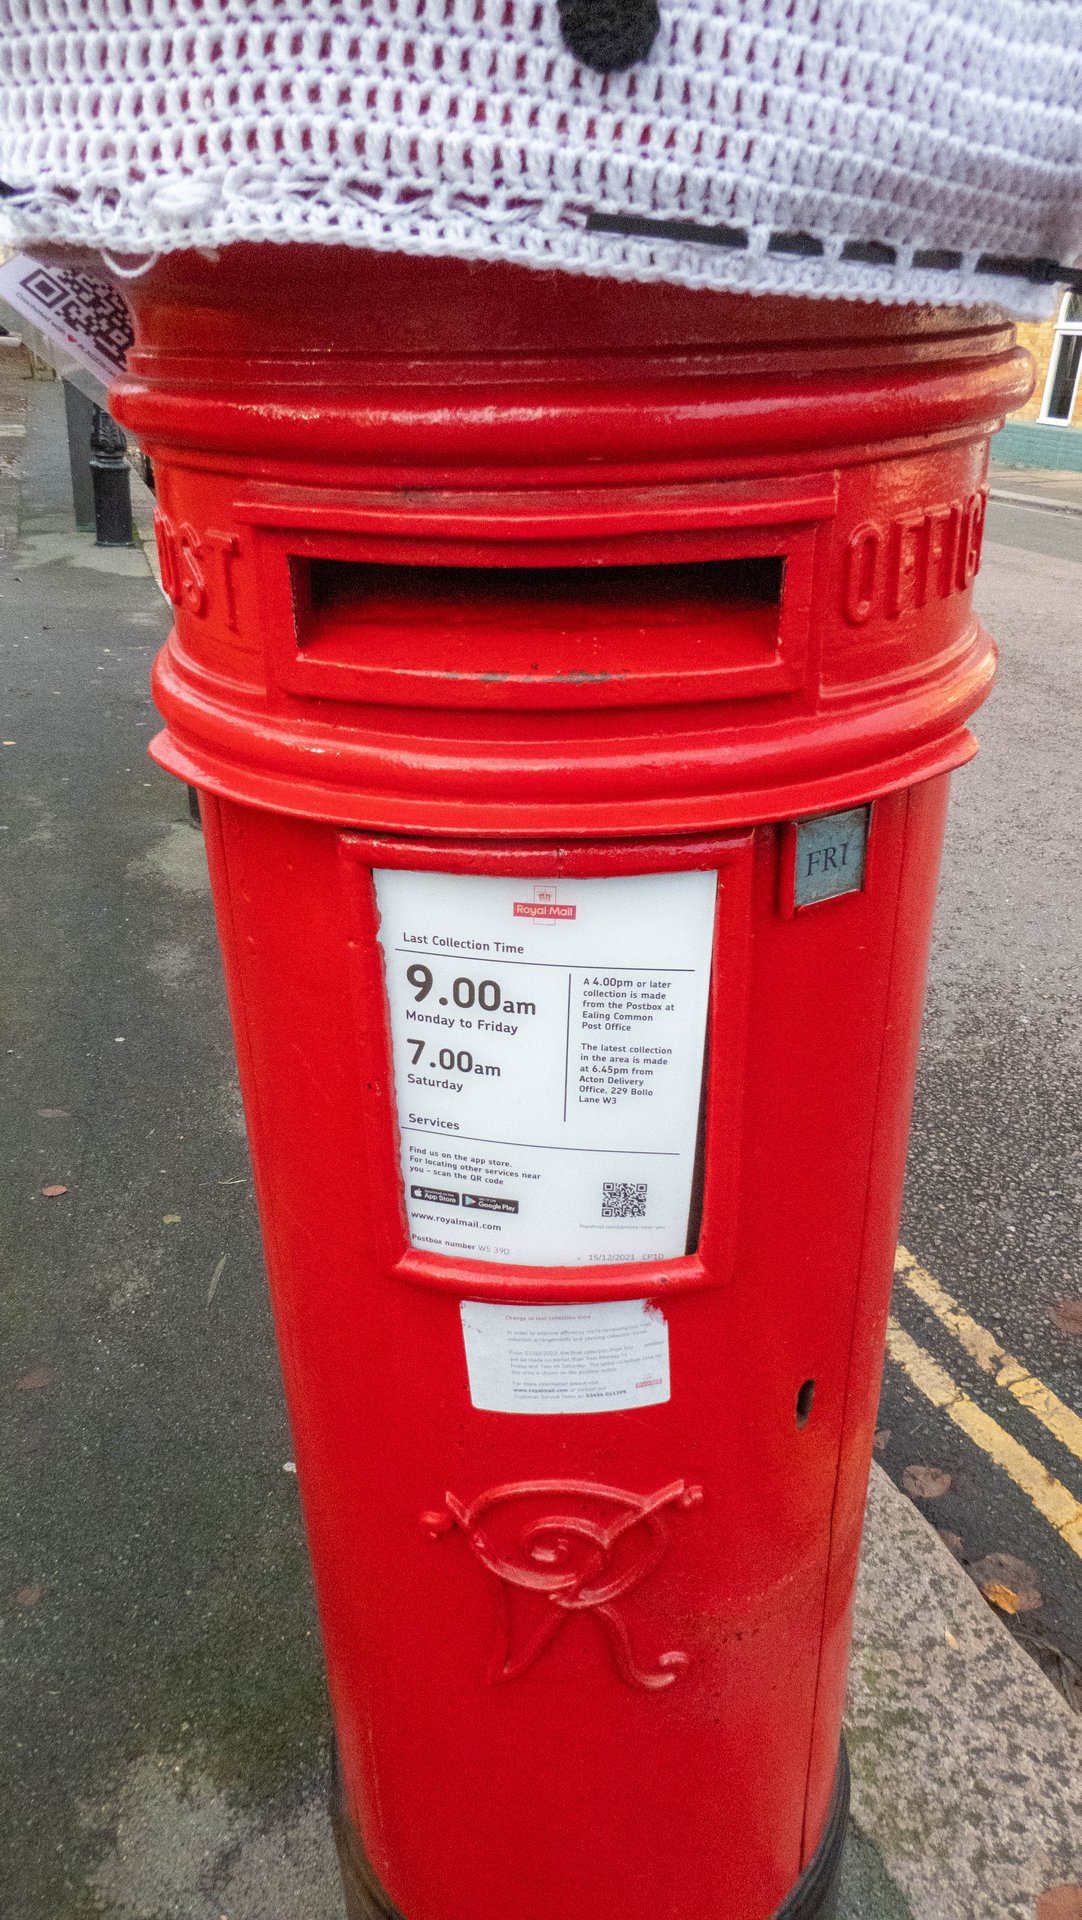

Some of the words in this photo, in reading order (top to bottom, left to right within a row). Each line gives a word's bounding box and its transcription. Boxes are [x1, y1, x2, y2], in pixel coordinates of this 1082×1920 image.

[153, 506, 240, 636] OST
[805, 842, 849, 878] FRI
[516, 904, 547, 916] Royal
[549, 906, 573, 917] Mail
[403, 932, 428, 945] Last
[432, 935, 490, 951] Collection
[494, 941, 524, 954] Time
[406, 963, 536, 1015] 9.00am
[583, 978, 590, 986] A
[592, 977, 633, 988] 4.00pm
[650, 980, 672, 988] later
[583, 989, 627, 998] collection
[630, 991, 638, 999] is
[641, 992, 666, 1000] made
[582, 1000, 605, 1008] from
[608, 1002, 623, 1010] the
[626, 1002, 662, 1011] Postbox
[406, 1009, 455, 1028] Monday
[460, 1018, 472, 1029] to
[478, 1019, 518, 1036] Friday
[582, 1011, 610, 1020] Ealing
[614, 1012, 654, 1022] Common
[582, 1022, 602, 1030] Post
[604, 1022, 632, 1032] Office
[580, 1042, 598, 1050] The
[600, 1044, 626, 1052] latest
[630, 1046, 672, 1054] collection
[406, 1038, 501, 1077] 7.00am
[592, 1054, 606, 1062] the
[610, 1056, 630, 1064] area
[632, 1056, 640, 1064] is
[592, 1065, 628, 1075] 6.45pm
[407, 1073, 464, 1093] Saturday
[608, 1076, 644, 1086] Delivery
[579, 1085, 608, 1094] Office,
[630, 1088, 654, 1096] Bollo
[578, 1096, 600, 1104] Lane
[602, 1096, 617, 1104] W3
[408, 1113, 460, 1130] Services
[409, 1146, 426, 1155] Find
[454, 1152, 468, 1162] the
[470, 1156, 486, 1166] app
[488, 1159, 512, 1168] store.
[410, 1155, 422, 1163] For
[426, 1158, 458, 1170] locating
[460, 1164, 482, 1172] other
[484, 1168, 519, 1178] services
[522, 1172, 542, 1180] near
[433, 1169, 452, 1177] scan
[454, 1172, 468, 1180] the
[470, 1174, 482, 1182] QR
[484, 1176, 504, 1185] code
[424, 1194, 438, 1202] App
[478, 1201, 501, 1210] Google
[502, 1204, 516, 1212] Play
[411, 1212, 502, 1231] www.royalmail.com
[412, 1233, 442, 1244] Postbox
[445, 1240, 476, 1250] number
[478, 1244, 491, 1252] W5
